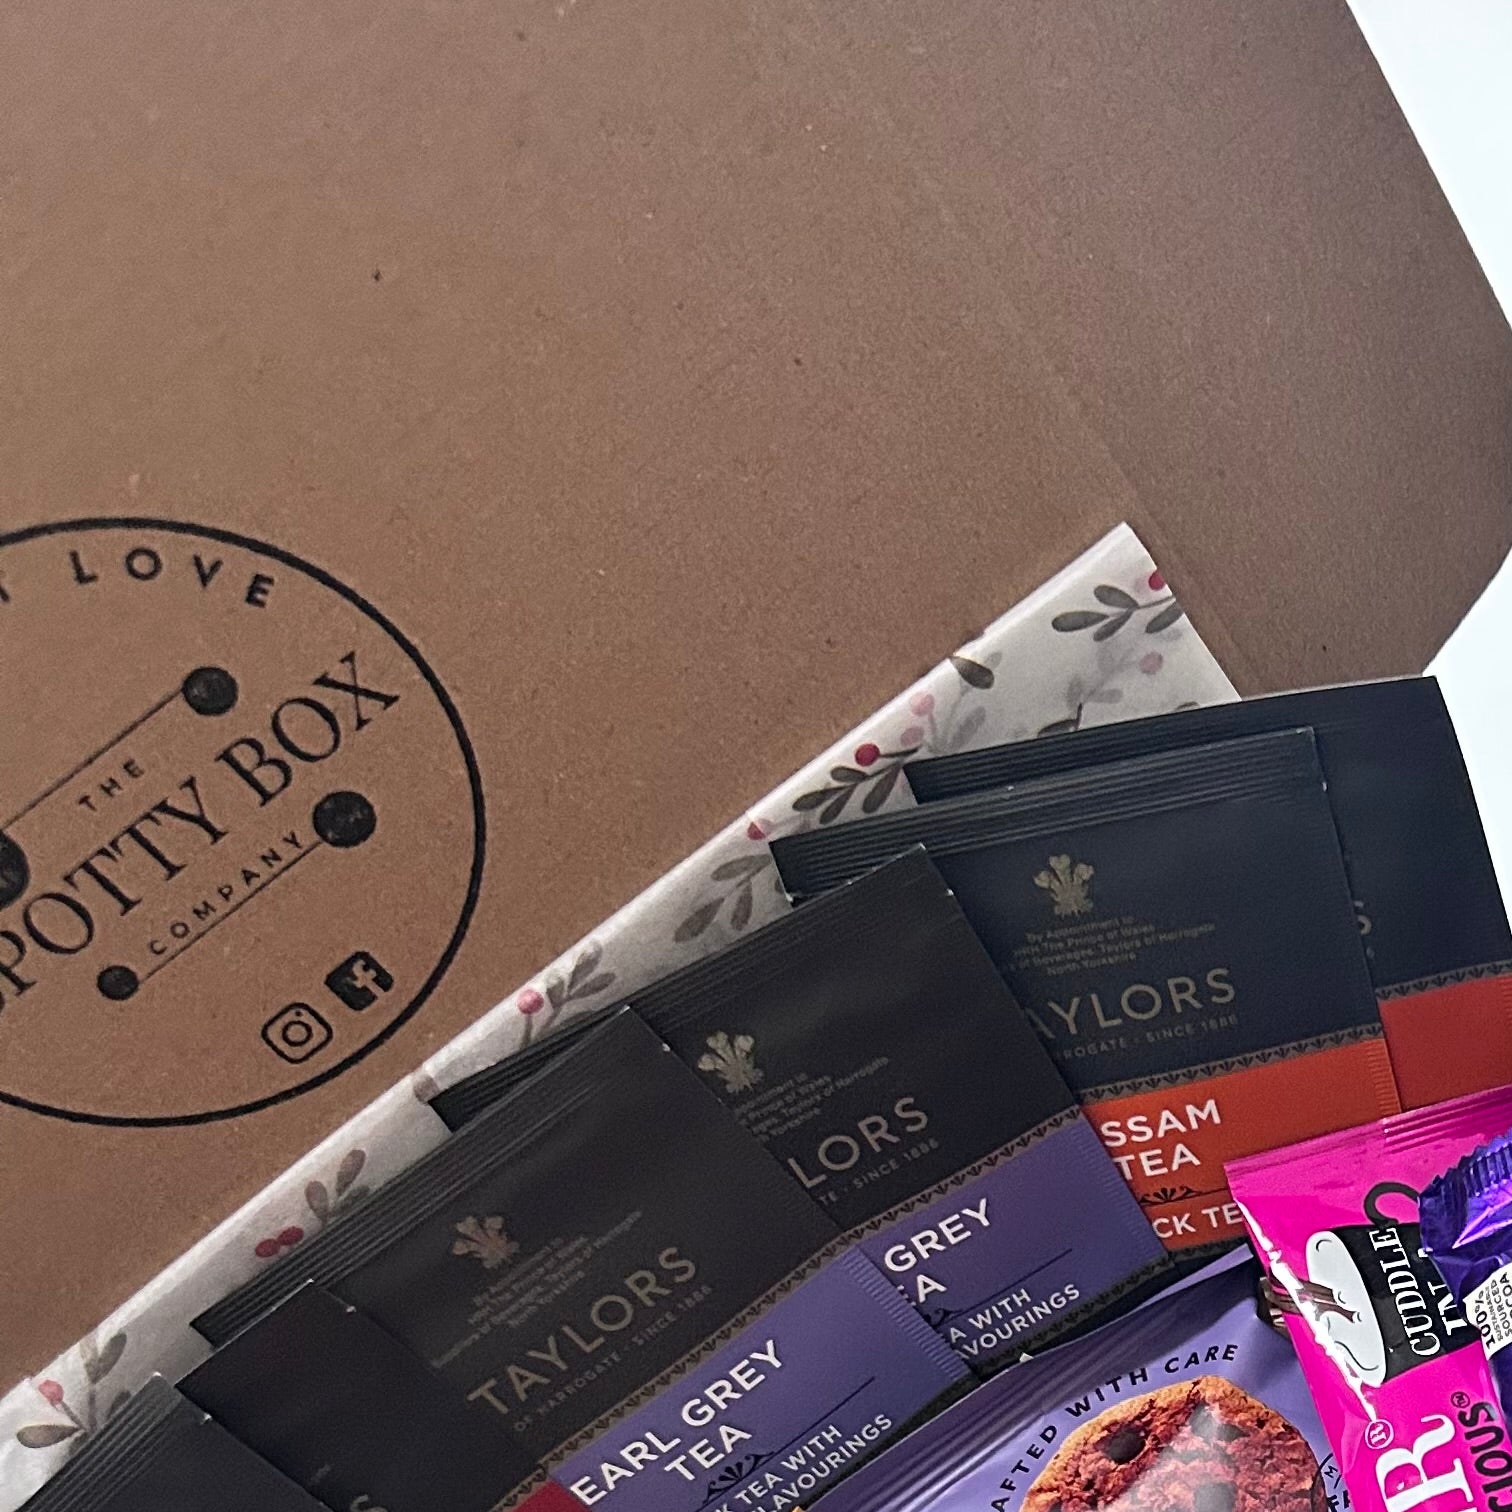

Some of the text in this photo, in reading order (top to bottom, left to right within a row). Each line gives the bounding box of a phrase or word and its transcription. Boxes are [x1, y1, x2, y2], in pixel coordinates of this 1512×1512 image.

[70, 547, 275, 608] LOVE
[79, 758, 145, 811] THE
[0, 651, 400, 1010] POTTY BOX
[149, 830, 304, 956] COMPANY
[1024, 967, 1236, 1040] YLORS
[787, 1096, 929, 1189] LORS
[1099, 1098, 1222, 1148] SSAM
[1114, 1142, 1201, 1181] TEA
[884, 1197, 992, 1273] GREY
[1200, 1202, 1245, 1230] TE
[955, 1283, 1080, 1360] VOURINGS
[968, 1287, 1032, 1330] WITH
[1368, 1227, 1441, 1357] CUDDLE
[465, 1246, 698, 1416] TAYLORS
[1065, 1367, 1149, 1418] WITH
[1164, 1343, 1239, 1374] CARE
[569, 1338, 783, 1507] EARL GREY
[663, 1422, 753, 1482] TEA
[733, 1471, 784, 1507] TEA
[781, 1423, 842, 1471] WITH
